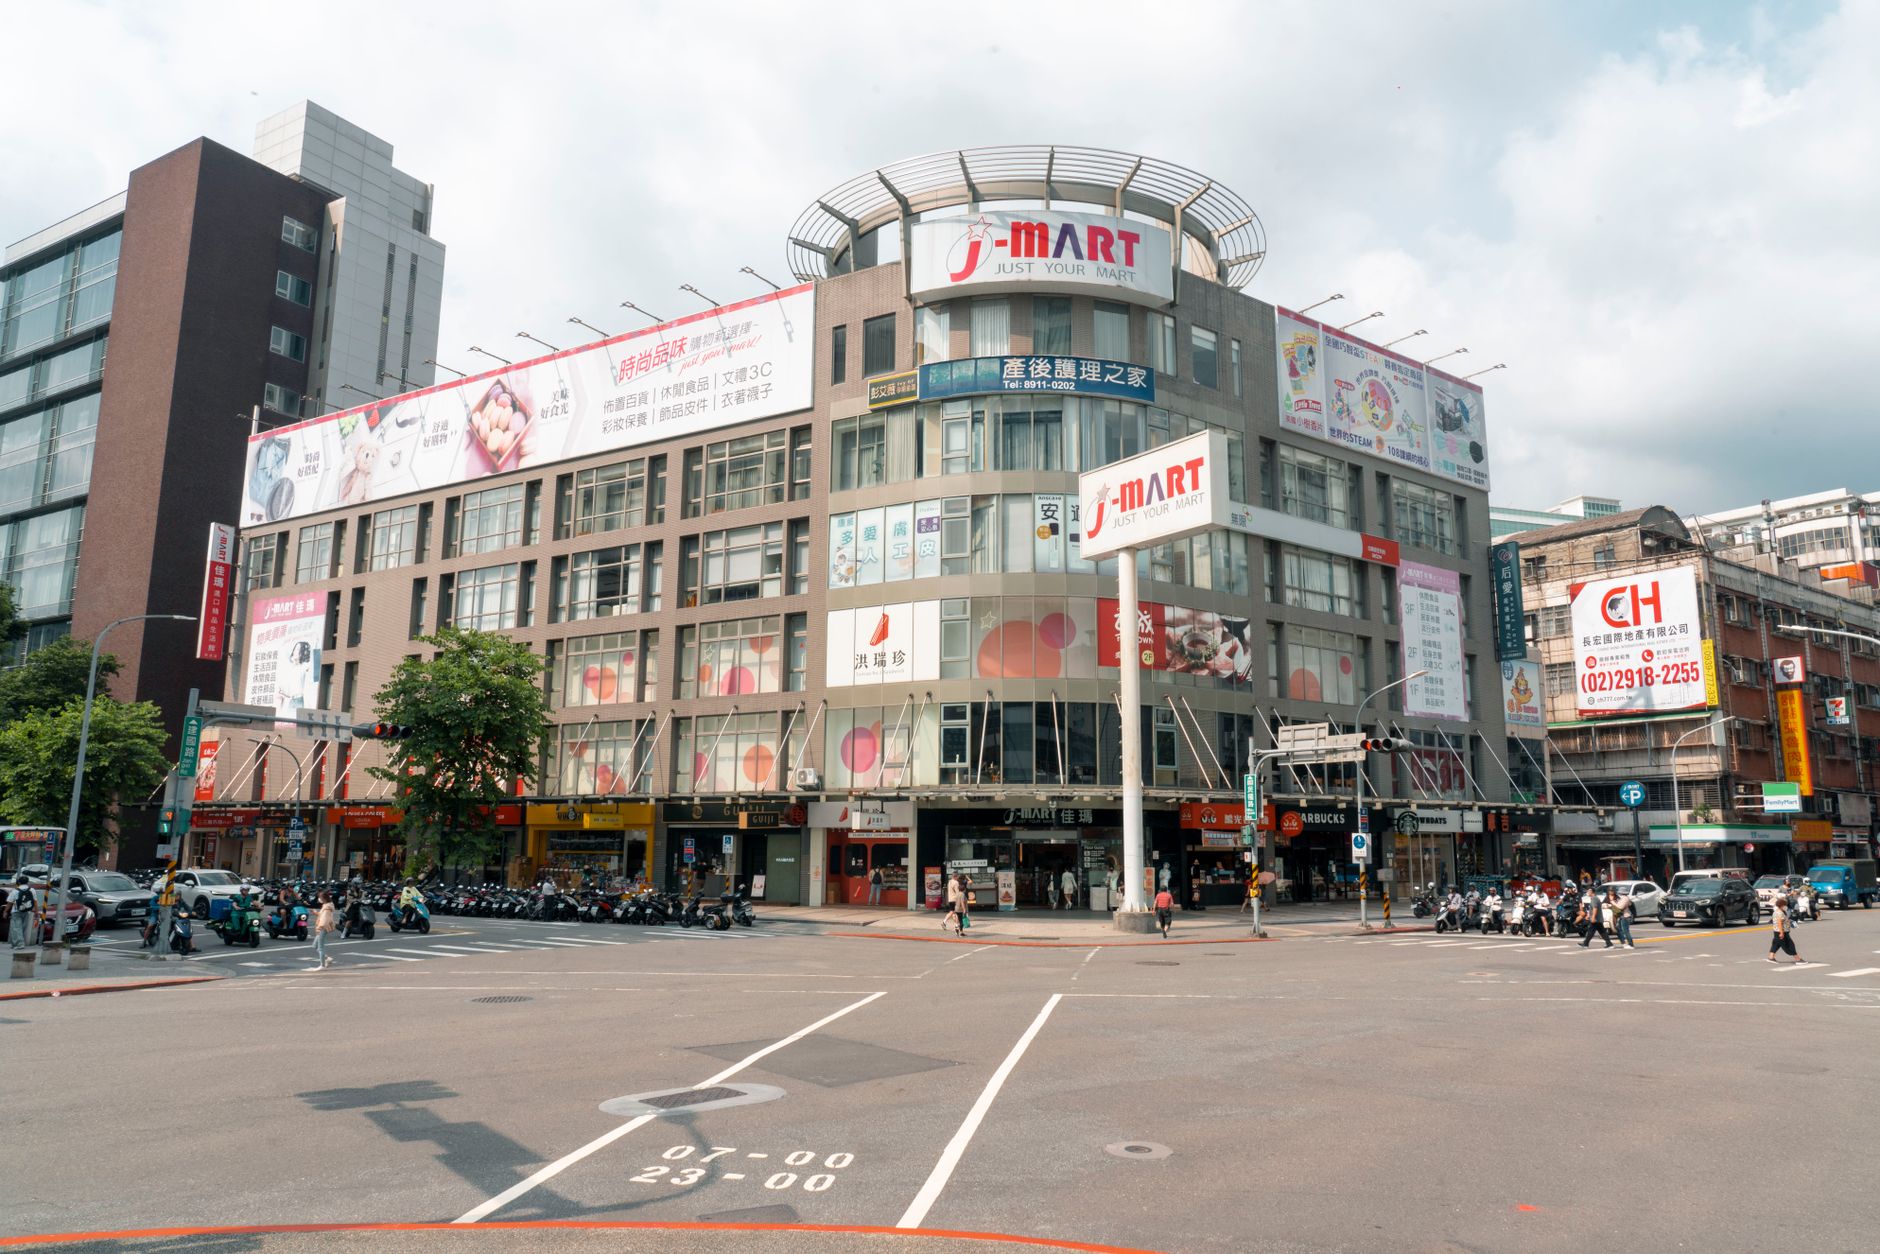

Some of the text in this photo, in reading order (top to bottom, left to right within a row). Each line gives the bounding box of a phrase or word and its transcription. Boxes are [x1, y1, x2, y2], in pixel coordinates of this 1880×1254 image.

[994, 262, 1136, 283] JUST YOUR MART
[618, 336, 688, 383] 時尚品味
[661, 376, 709, 399] 休閒食品
[722, 361, 773, 387] 文禮3C
[1003, 357, 1147, 388] 產後護理之家
[1024, 381, 1076, 391] 8911-0202
[602, 412, 647, 435] 彩妝保養
[659, 398, 708, 423] 飾品皮件
[1113, 492, 1206, 529] JUST YOUR MART
[1404, 602, 1415, 616] 3F
[1582, 623, 1689, 647] 長宏國際地產有限公司
[854, 650, 906, 670] 洪瑞珍
[1143, 652, 1153, 661] 2F
[1407, 646, 1417, 658] 2F
[1581, 661, 1700, 693] (02)2918-2255
[1410, 683, 1419, 696] 1F
[1630, 790, 1641, 804] P
[752, 815, 774, 825] GUIJI
[1061, 809, 1093, 824] 佳瑪
[1299, 812, 1346, 824] ARBUCKS
[1418, 816, 1448, 825] WNDAYS
[661, 1145, 855, 1170] 07-00
[629, 1165, 836, 1192] 23-00
